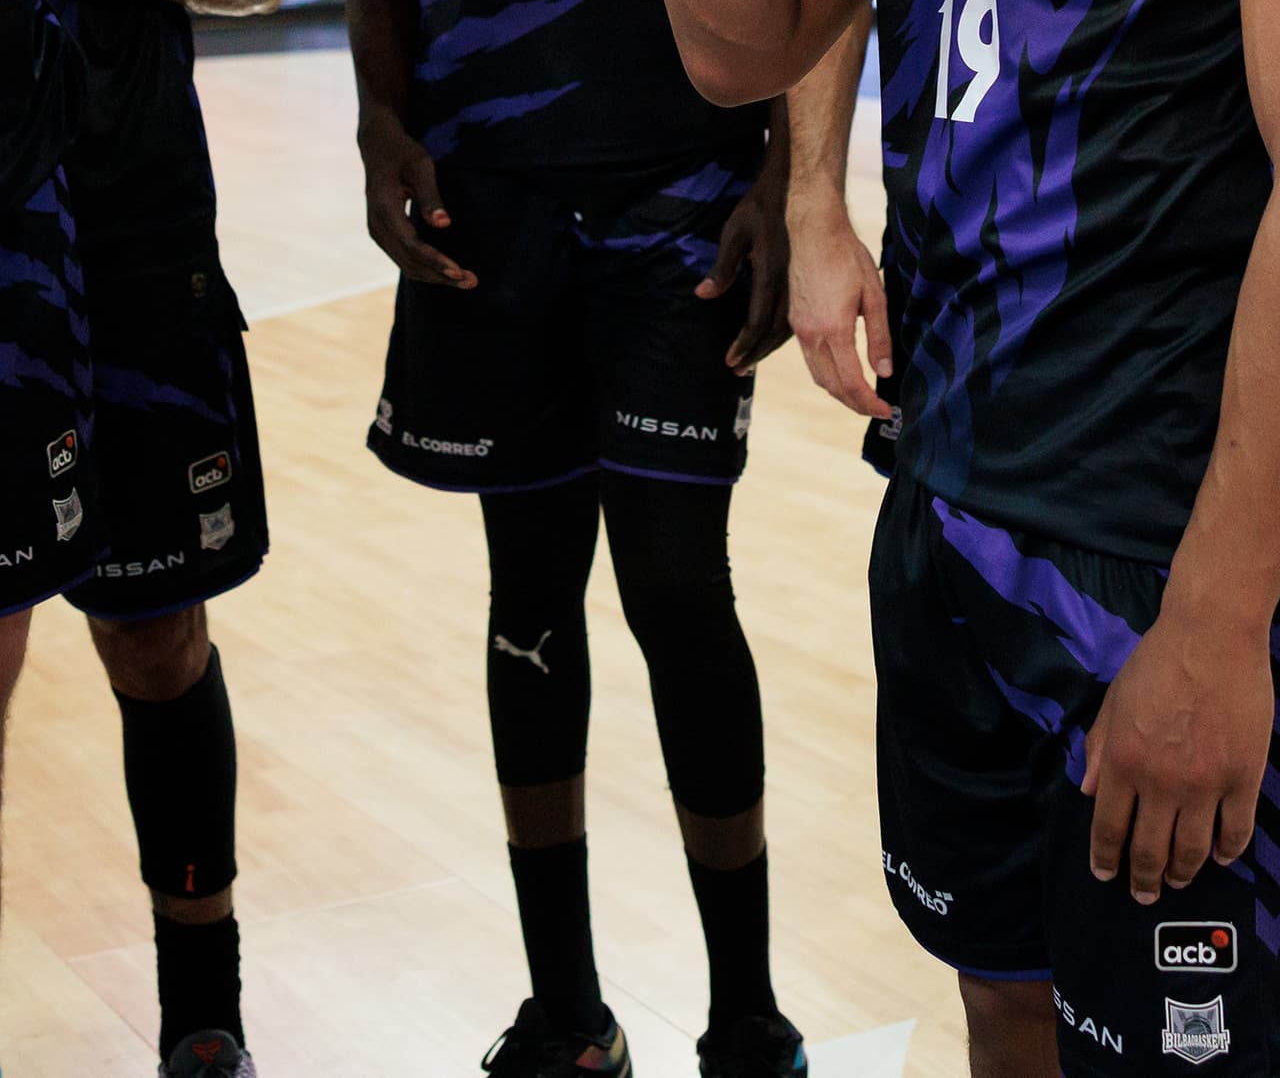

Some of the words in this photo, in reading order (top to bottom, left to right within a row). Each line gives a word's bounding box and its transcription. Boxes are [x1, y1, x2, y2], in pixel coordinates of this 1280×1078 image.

[616, 410, 718, 441] NISSAN
[420, 437, 488, 456] CORREO
[52, 448, 72, 471] acb
[195, 470, 223, 488] acb
[1163, 942, 1217, 964] acb
